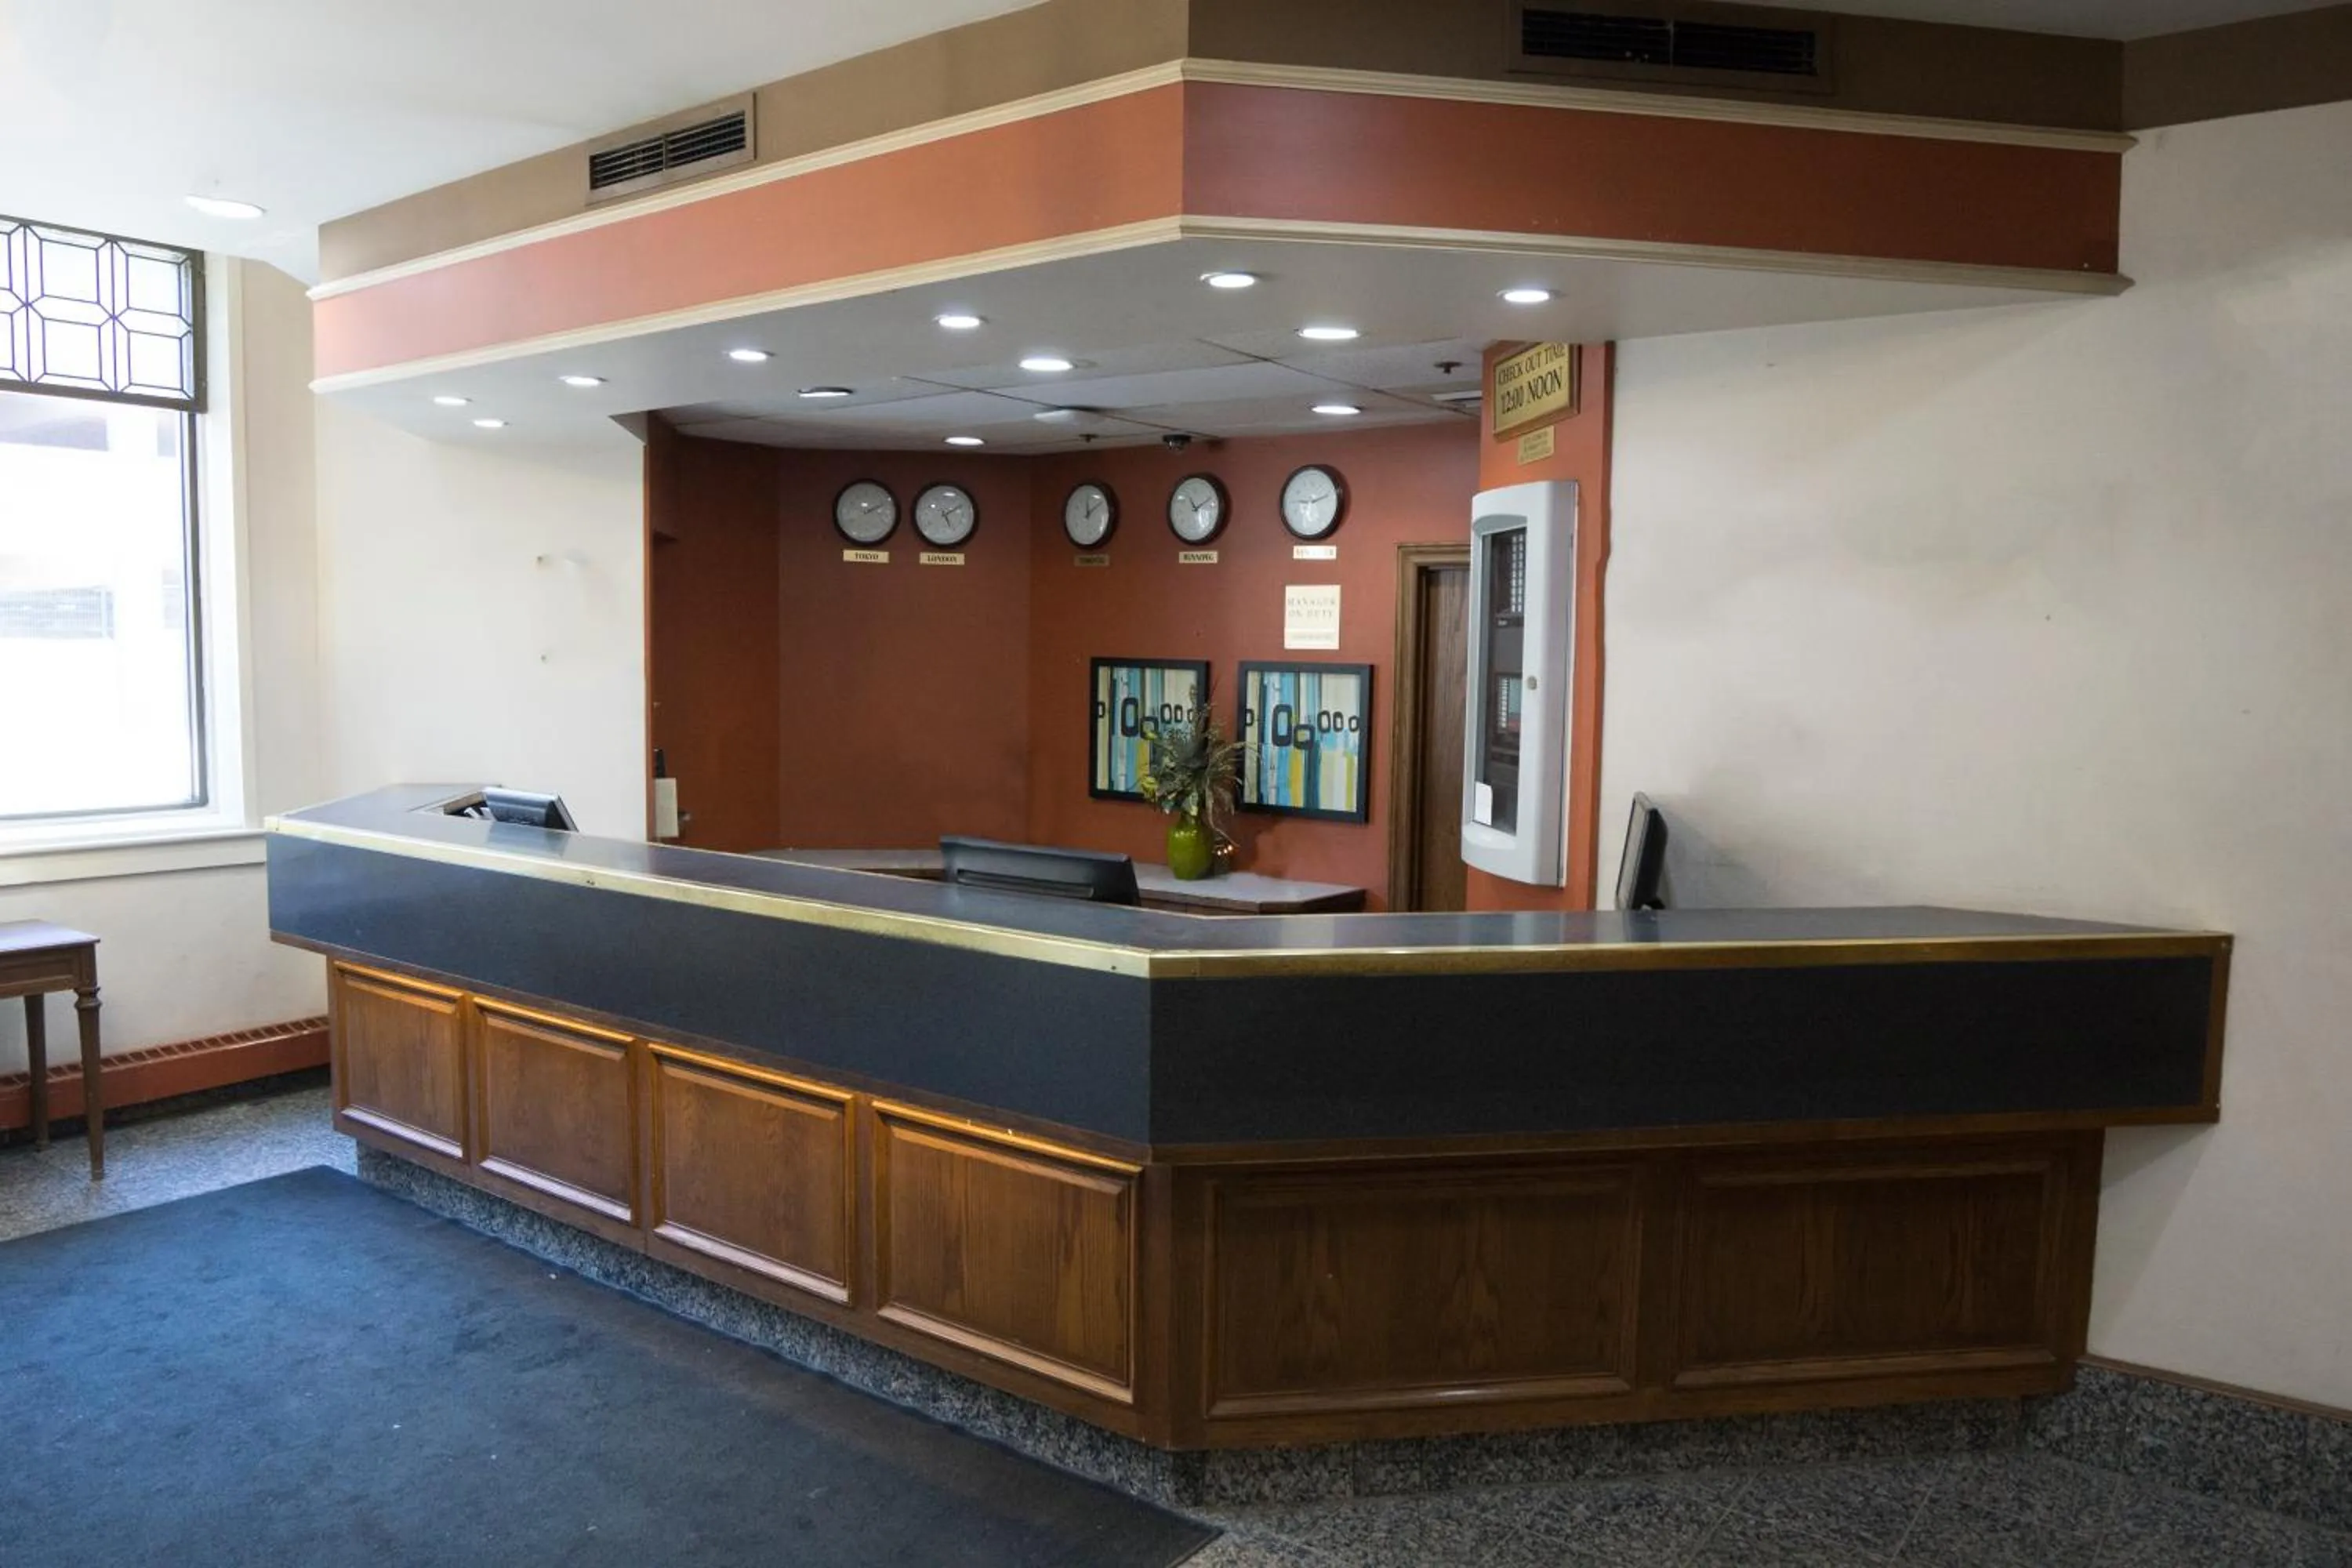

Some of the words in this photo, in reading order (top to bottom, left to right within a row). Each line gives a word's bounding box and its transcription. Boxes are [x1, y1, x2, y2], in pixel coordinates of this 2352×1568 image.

[1498, 362, 1523, 384] CHECK
[1525, 351, 1541, 373] OUT
[1501, 386, 1524, 414] 12:00
[1526, 366, 1562, 402] NOON
